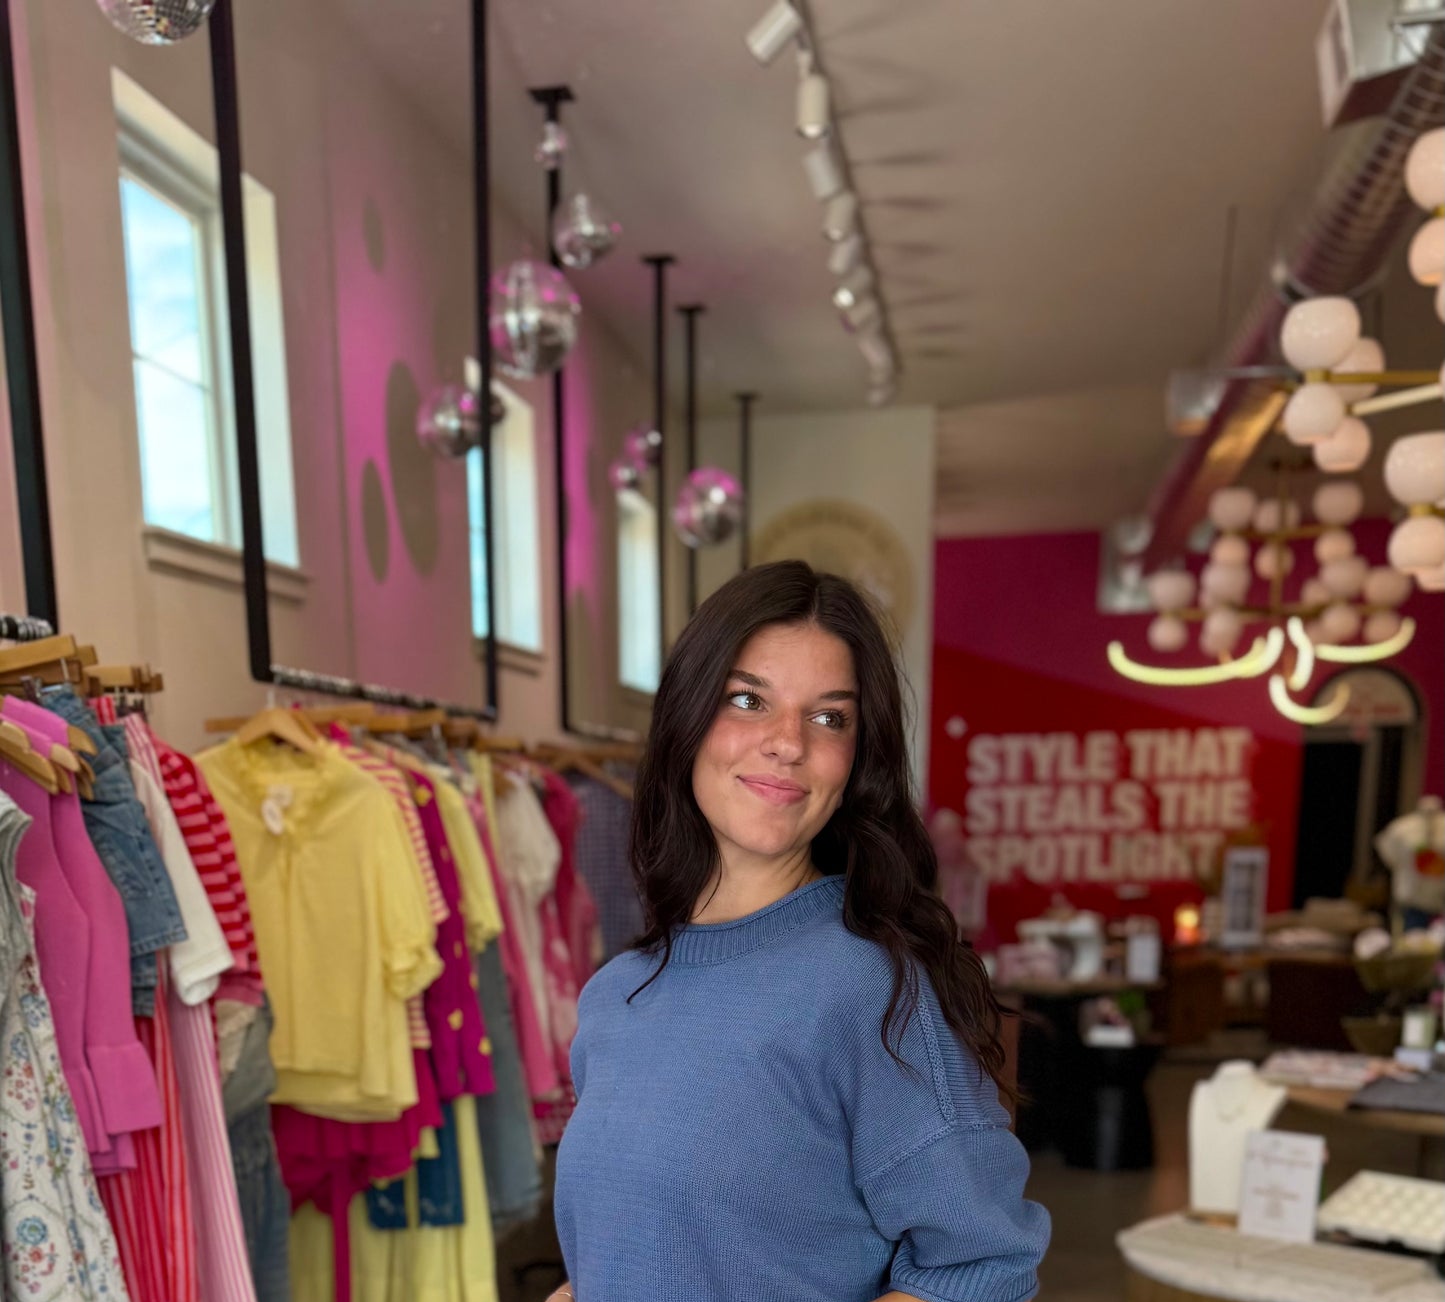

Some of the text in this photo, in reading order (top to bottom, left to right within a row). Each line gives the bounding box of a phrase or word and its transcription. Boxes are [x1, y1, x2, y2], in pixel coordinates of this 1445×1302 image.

[968, 729, 1251, 783] STYLE THAT
[966, 780, 1251, 832] STEALS THE
